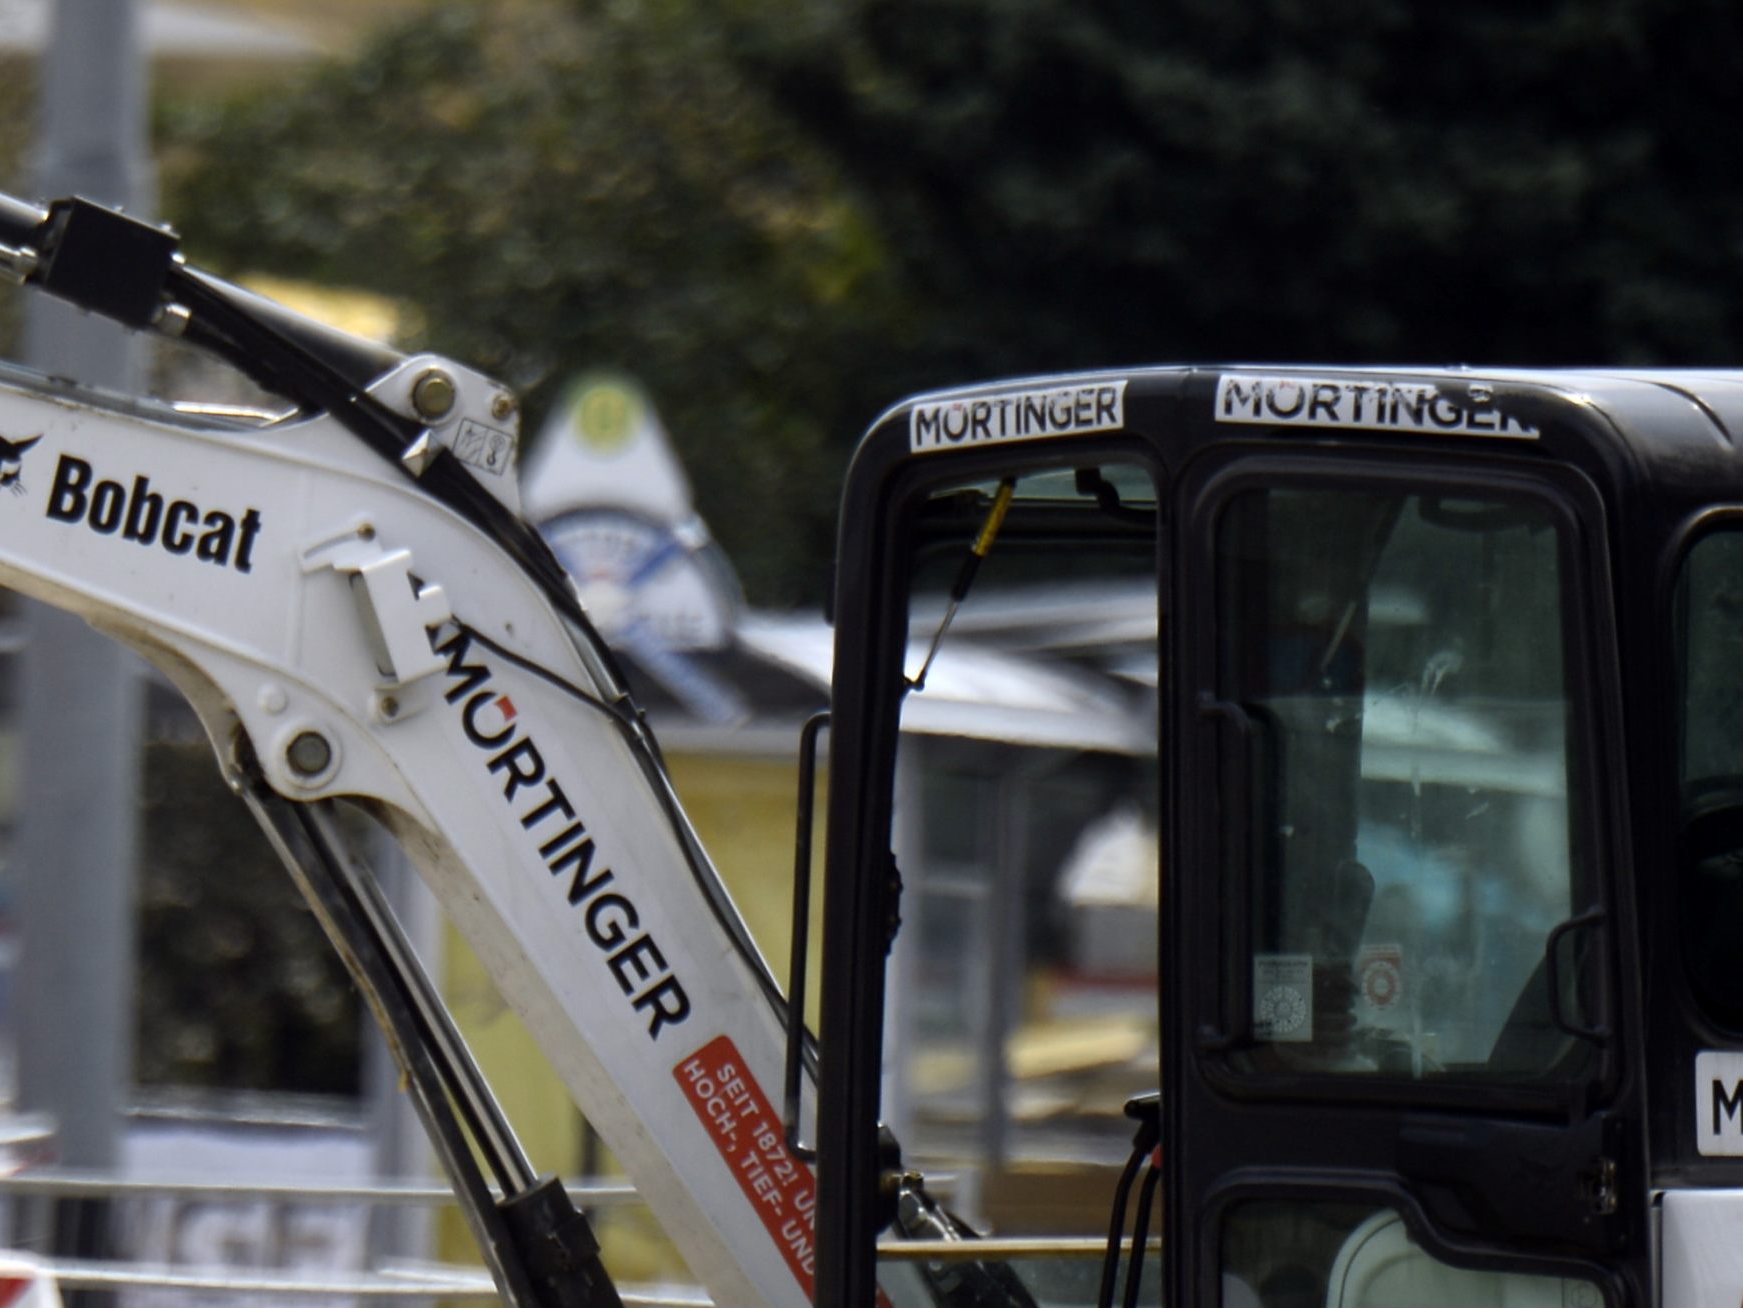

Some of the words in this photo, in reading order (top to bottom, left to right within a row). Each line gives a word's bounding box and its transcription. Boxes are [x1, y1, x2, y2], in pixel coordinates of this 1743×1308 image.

[46, 454, 262, 574] Bobcat
[684, 1060, 738, 1152] HOCH-,
[740, 1151, 782, 1216] TIEF-
[717, 1064, 759, 1117] SEIT
[753, 1122, 799, 1187] 1872!
